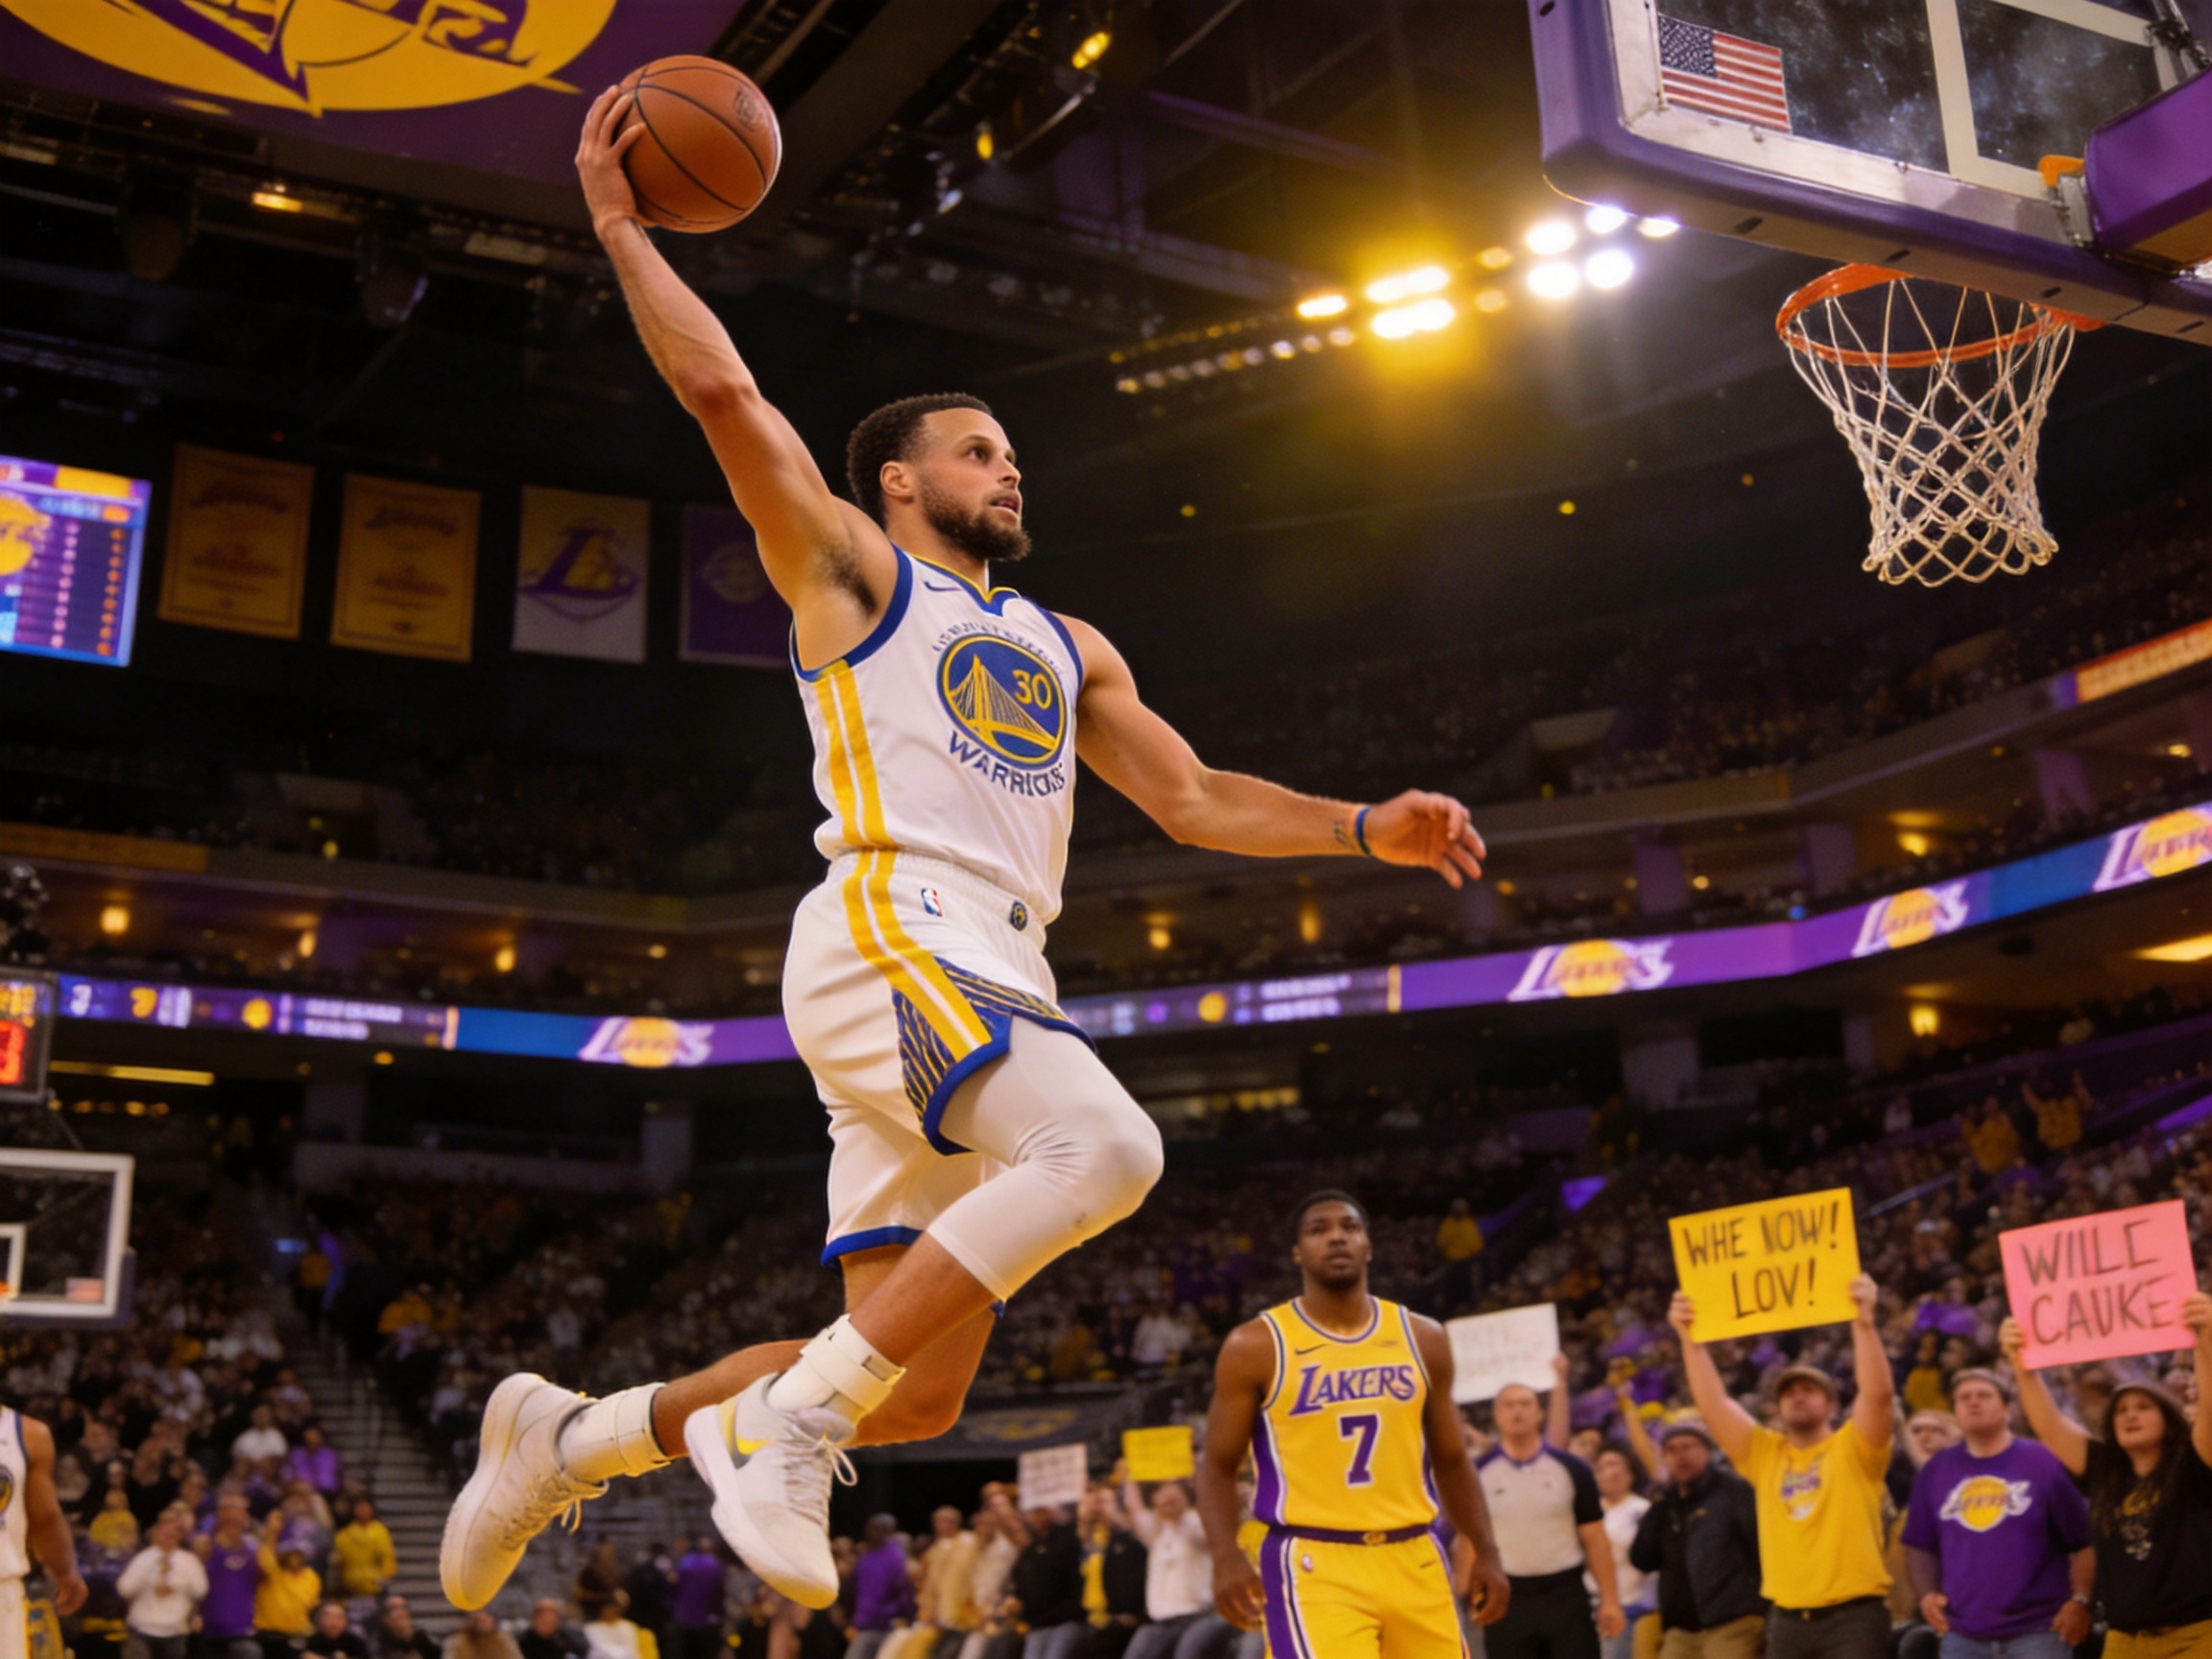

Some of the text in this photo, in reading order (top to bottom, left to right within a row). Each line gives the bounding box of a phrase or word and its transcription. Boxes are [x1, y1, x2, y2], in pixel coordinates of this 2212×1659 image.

[1012, 669, 1052, 709] 30
[1732, 1257, 1815, 1319] LOV!
[1287, 1363, 1416, 1416] LAKERS
[1339, 1414, 1379, 1484] 7
